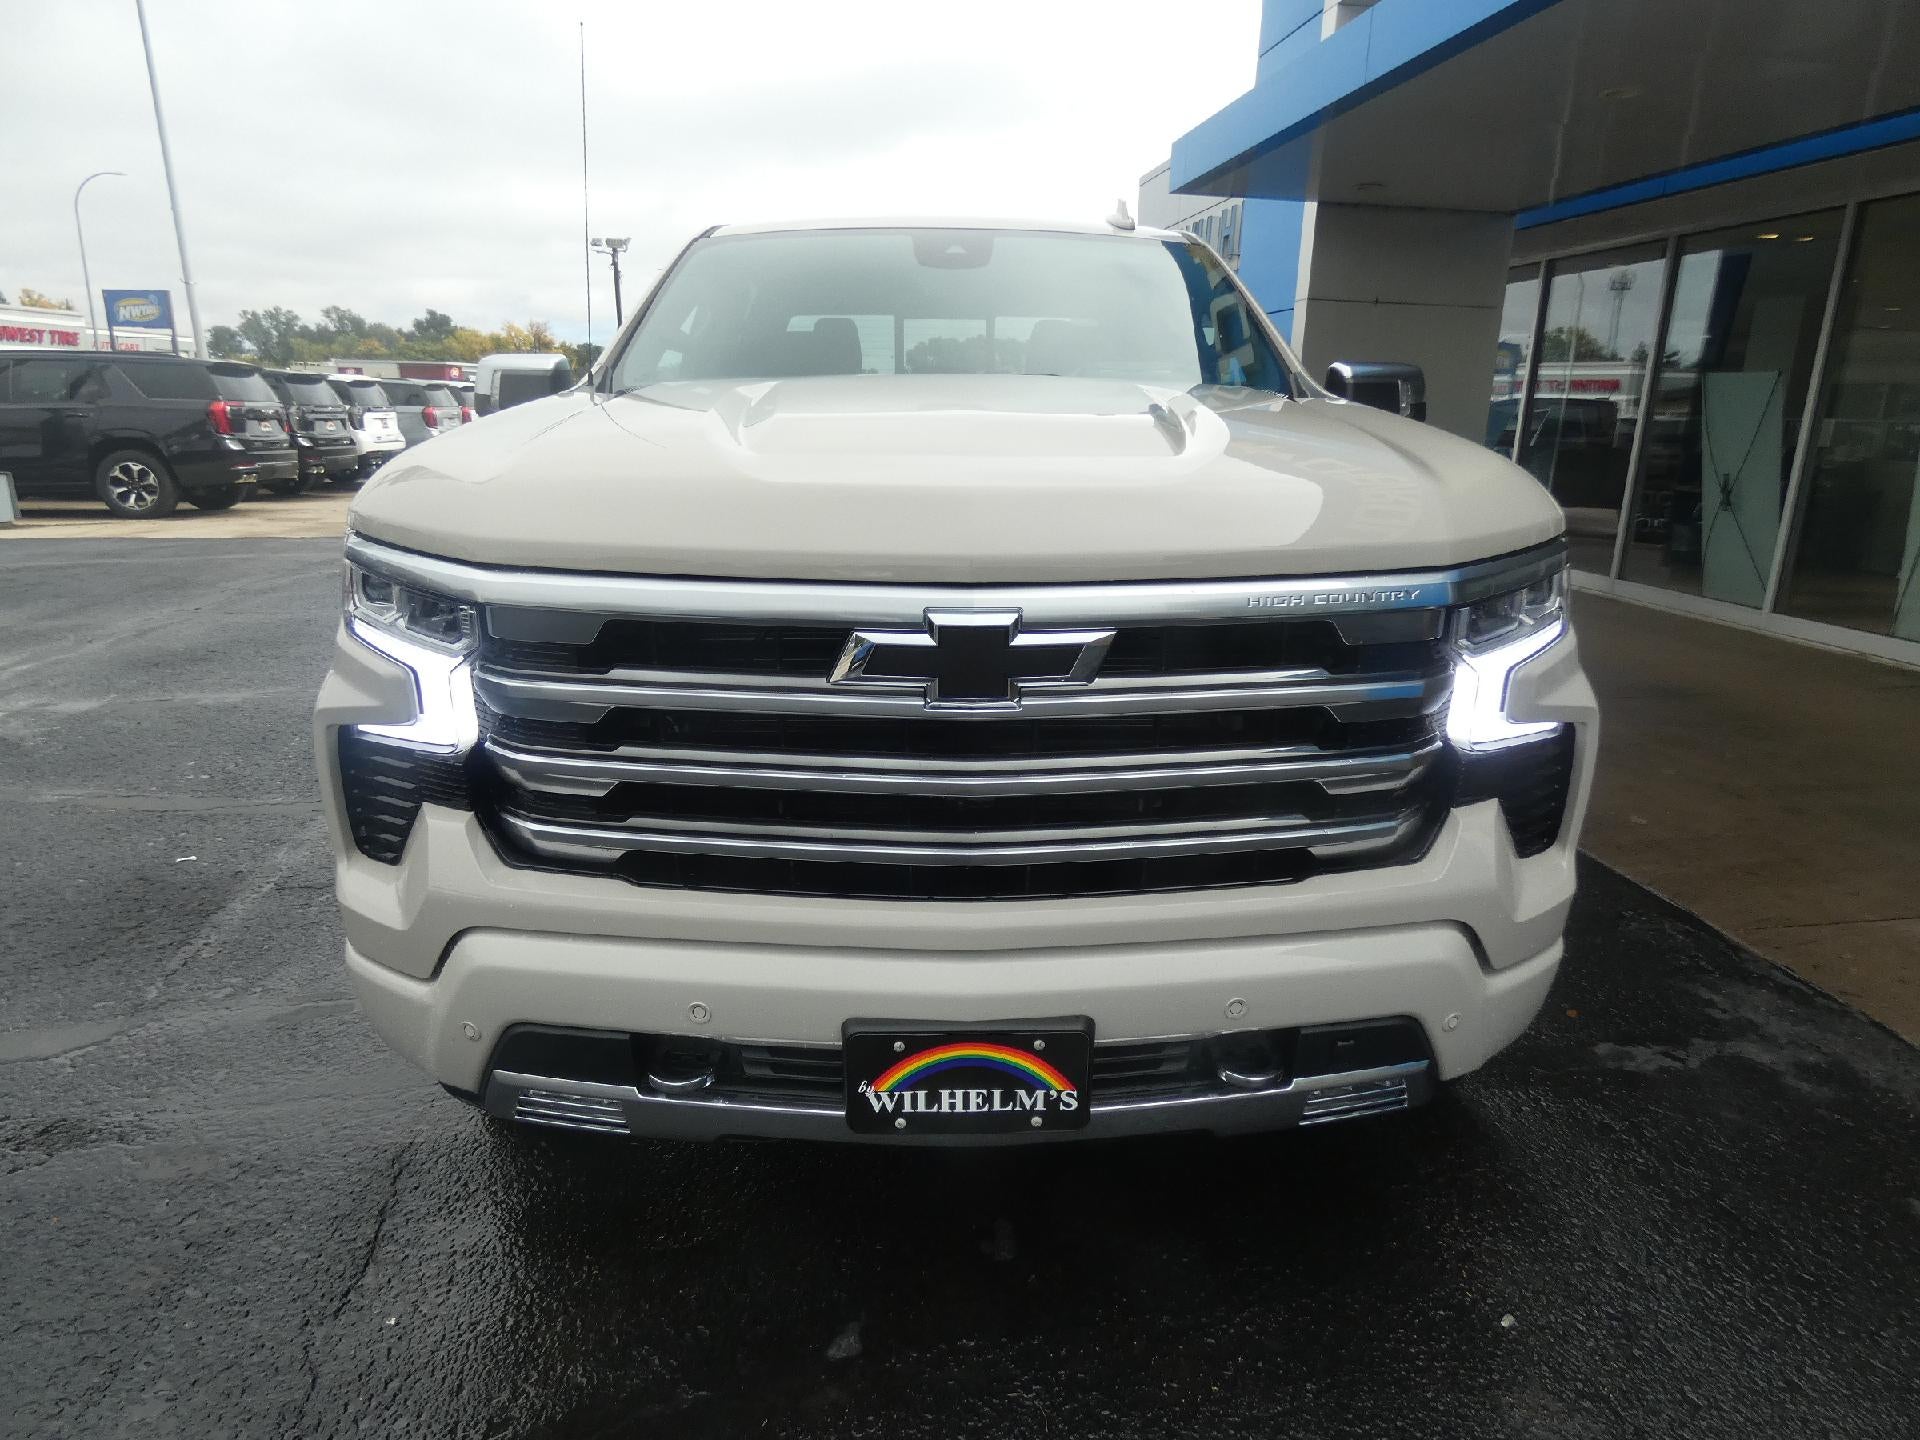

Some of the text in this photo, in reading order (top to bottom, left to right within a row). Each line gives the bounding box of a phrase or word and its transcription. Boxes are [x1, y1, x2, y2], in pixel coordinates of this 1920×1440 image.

[1247, 589, 1421, 608] HIGH COUNTRY
[868, 1088, 1079, 1114] WILHELM'S
